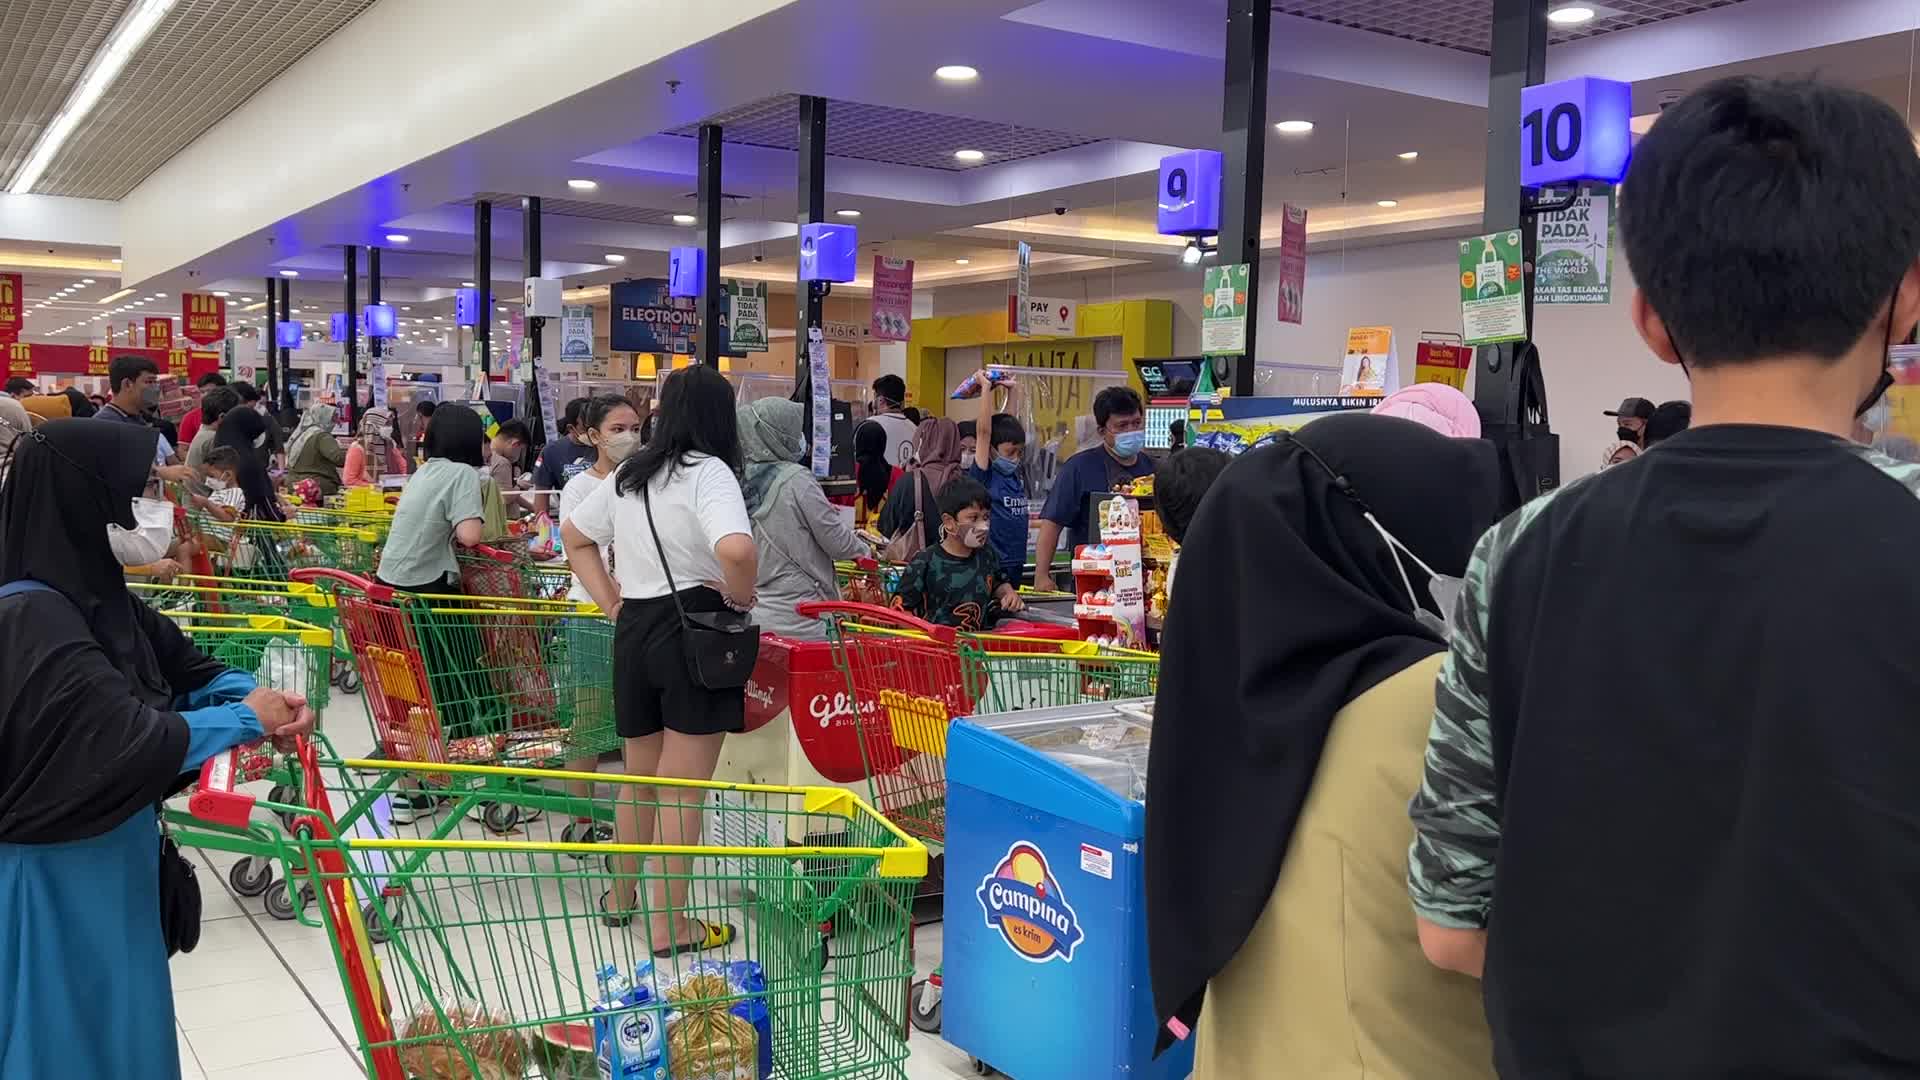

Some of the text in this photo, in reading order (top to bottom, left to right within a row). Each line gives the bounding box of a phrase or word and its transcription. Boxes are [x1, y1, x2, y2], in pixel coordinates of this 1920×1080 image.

[1523, 102, 1581, 166] 10
[1167, 168, 1188, 212] 9
[1541, 223, 1589, 238] PADA
[672, 258, 680, 288] 7
[738, 310, 758, 318] PADA
[1031, 302, 1049, 312] PAY
[1031, 314, 1051, 325] HERE
[1292, 398, 1338, 406] MULUSNYA
[1341, 398, 1366, 406] BIKIN
[989, 882, 1070, 935] Campina
[1022, 925, 1041, 944] krim
